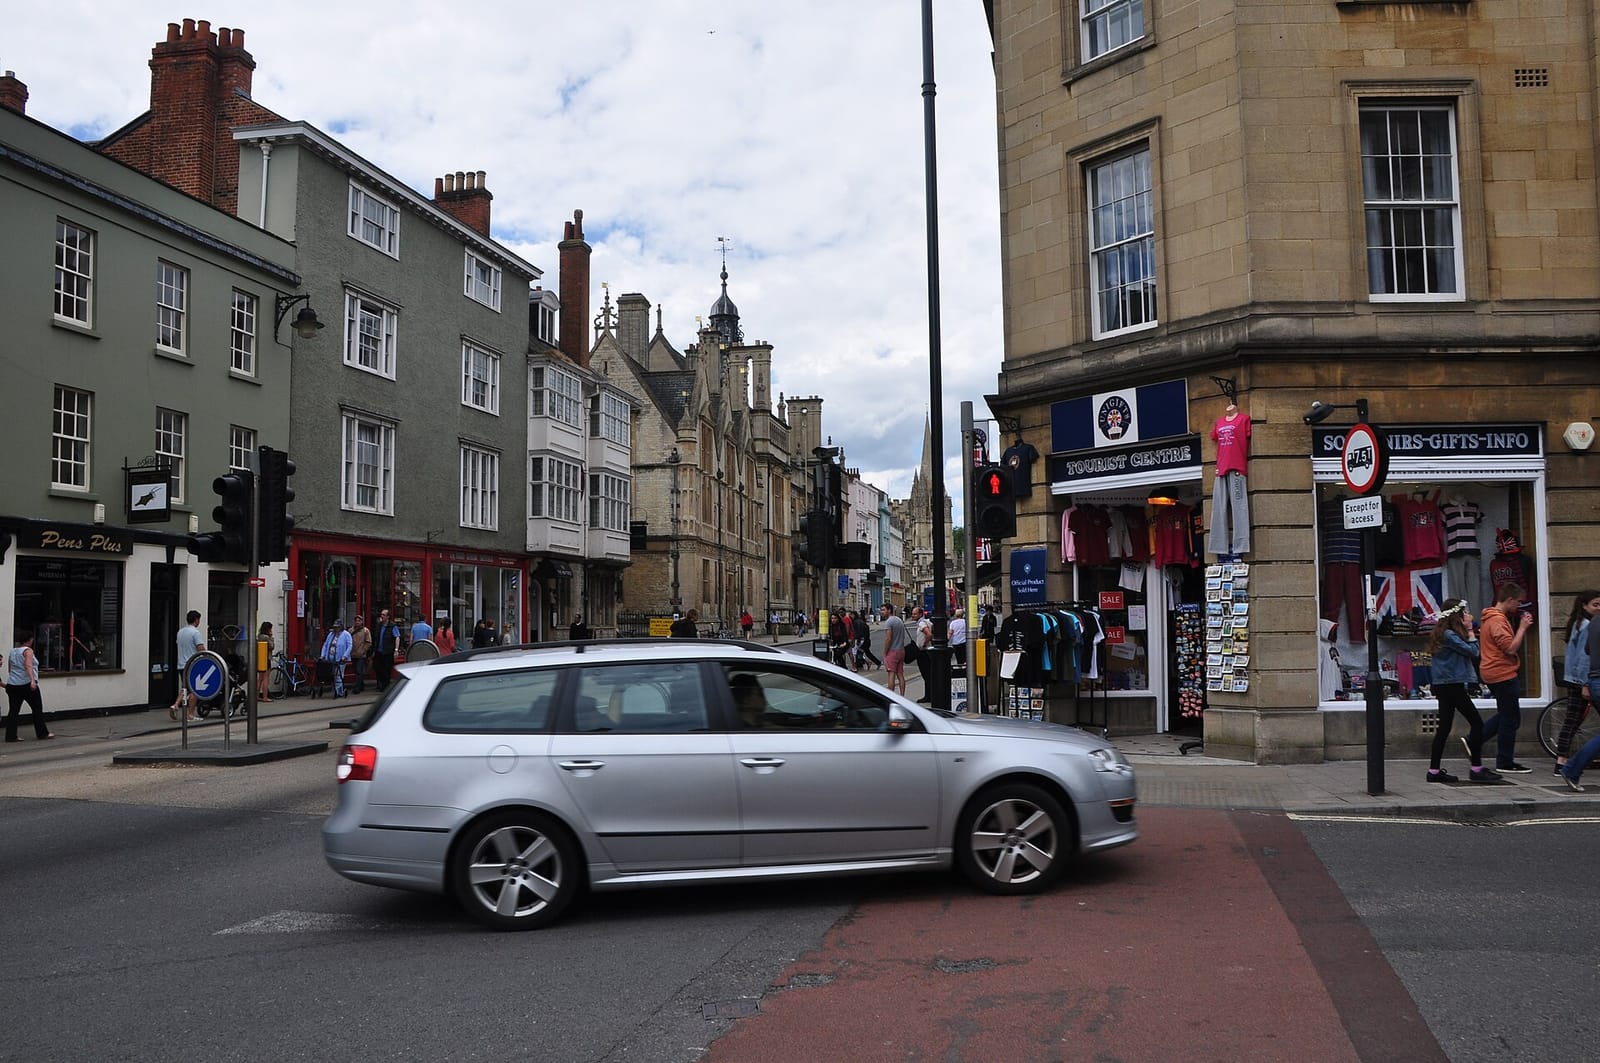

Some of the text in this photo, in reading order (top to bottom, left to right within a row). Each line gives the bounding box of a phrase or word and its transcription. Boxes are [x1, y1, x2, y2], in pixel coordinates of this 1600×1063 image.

[1066, 445, 1192, 475] TOURIST CENTRE
[1345, 501, 1379, 513] Except for
[1351, 515, 1374, 524] access
[41, 530, 122, 552] Pens Plus
[1102, 596, 1120, 604] SALE
[1106, 631, 1121, 639] ALE
